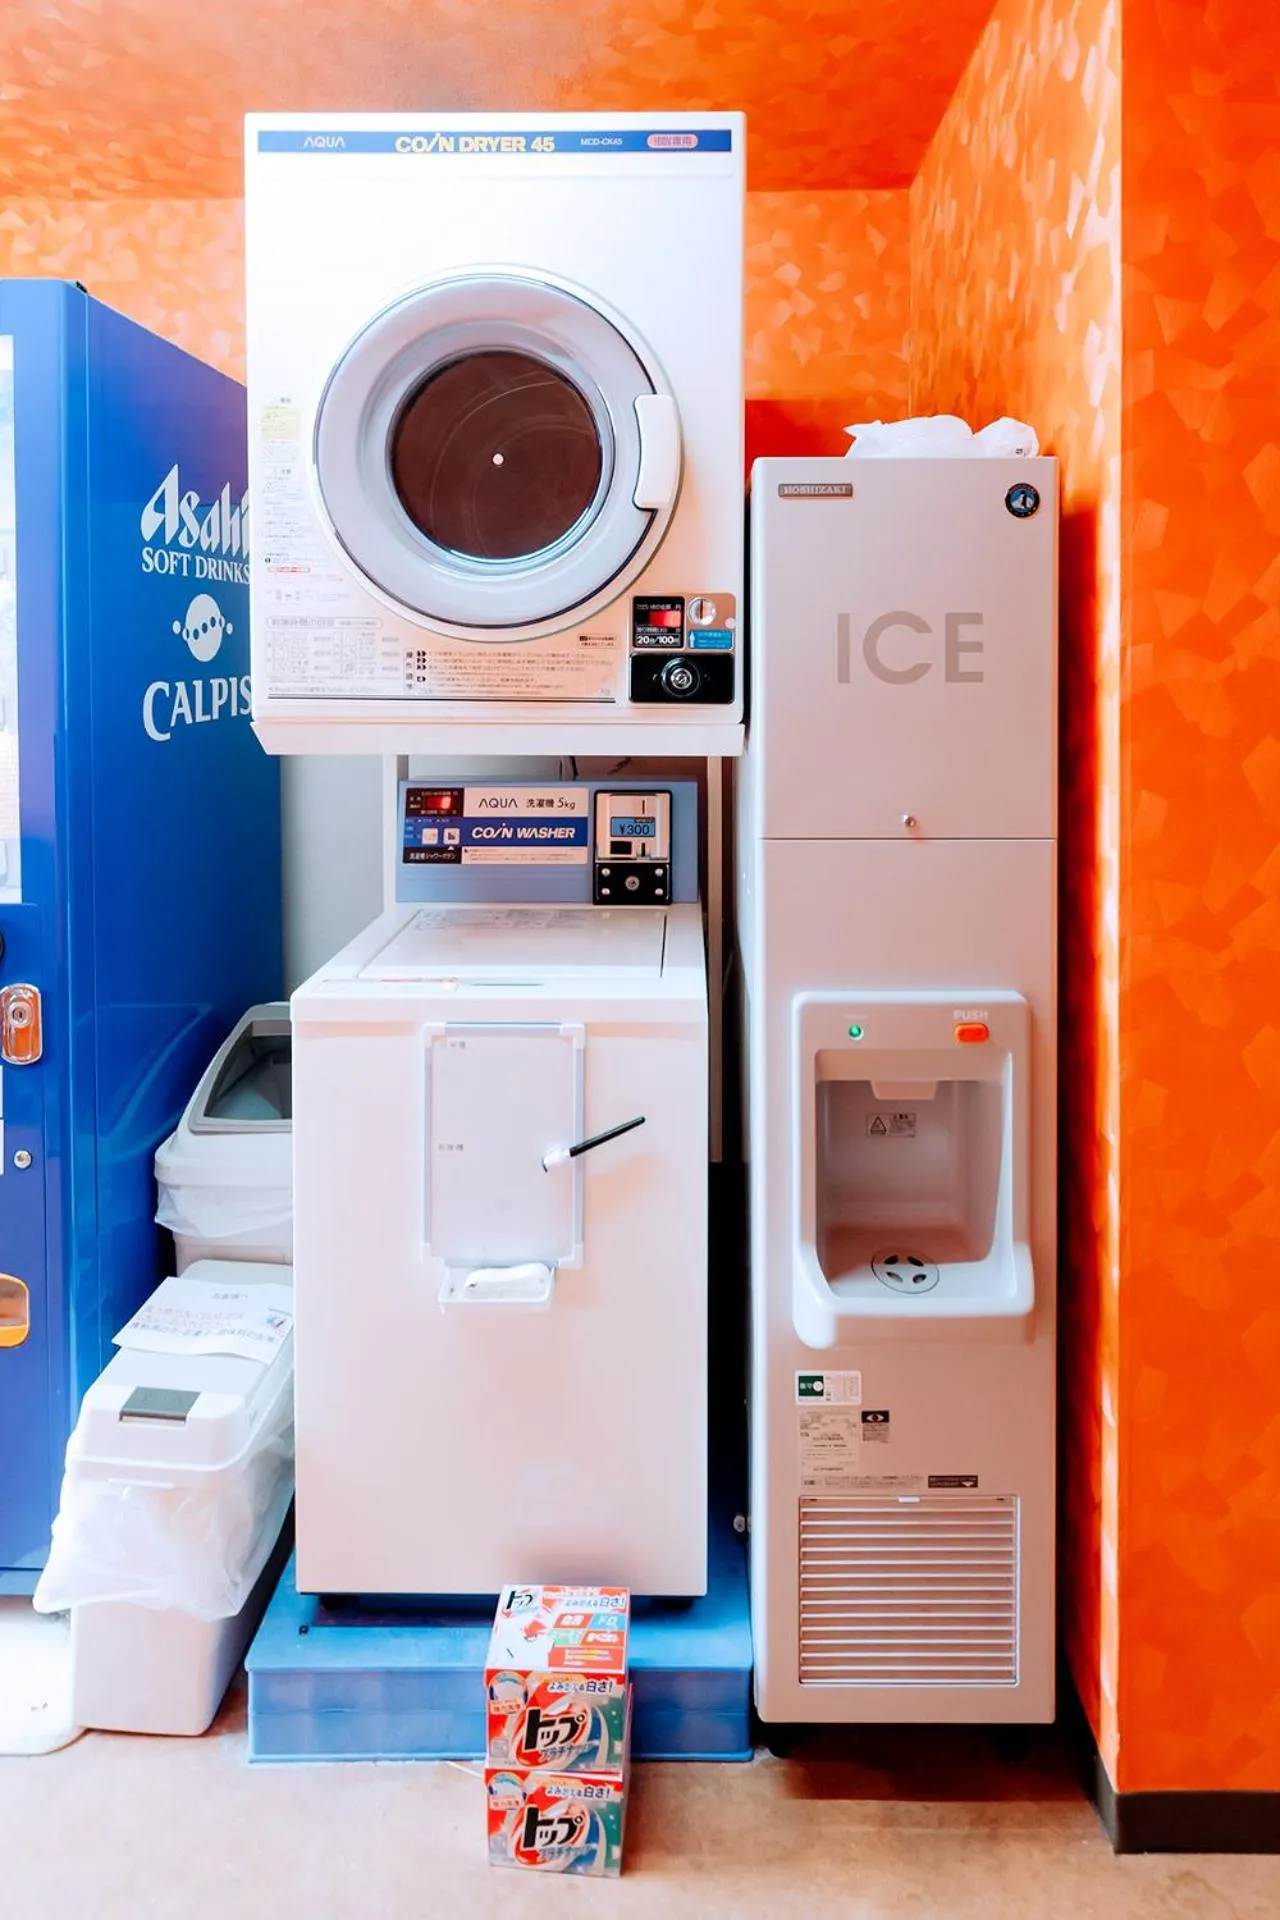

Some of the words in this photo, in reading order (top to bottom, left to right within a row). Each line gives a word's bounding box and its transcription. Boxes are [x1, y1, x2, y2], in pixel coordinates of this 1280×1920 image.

[303, 136, 346, 149] AQUA
[459, 136, 527, 153] DRYER
[530, 137, 555, 153] 45
[142, 546, 191, 577] SOFT
[195, 554, 250, 585] DRINKS
[837, 610, 984, 685] ICE
[142, 675, 251, 742] CALPIS
[478, 798, 518, 809] AQUA
[526, 798, 555, 809] 洗濯機
[557, 797, 576, 811] 5kg
[517, 826, 576, 839] WASHER
[619, 824, 651, 836] ¥300
[953, 1009, 988, 1021] PUSH
[524, 1708, 585, 1751] トップ
[523, 1806, 584, 1849] トップ
